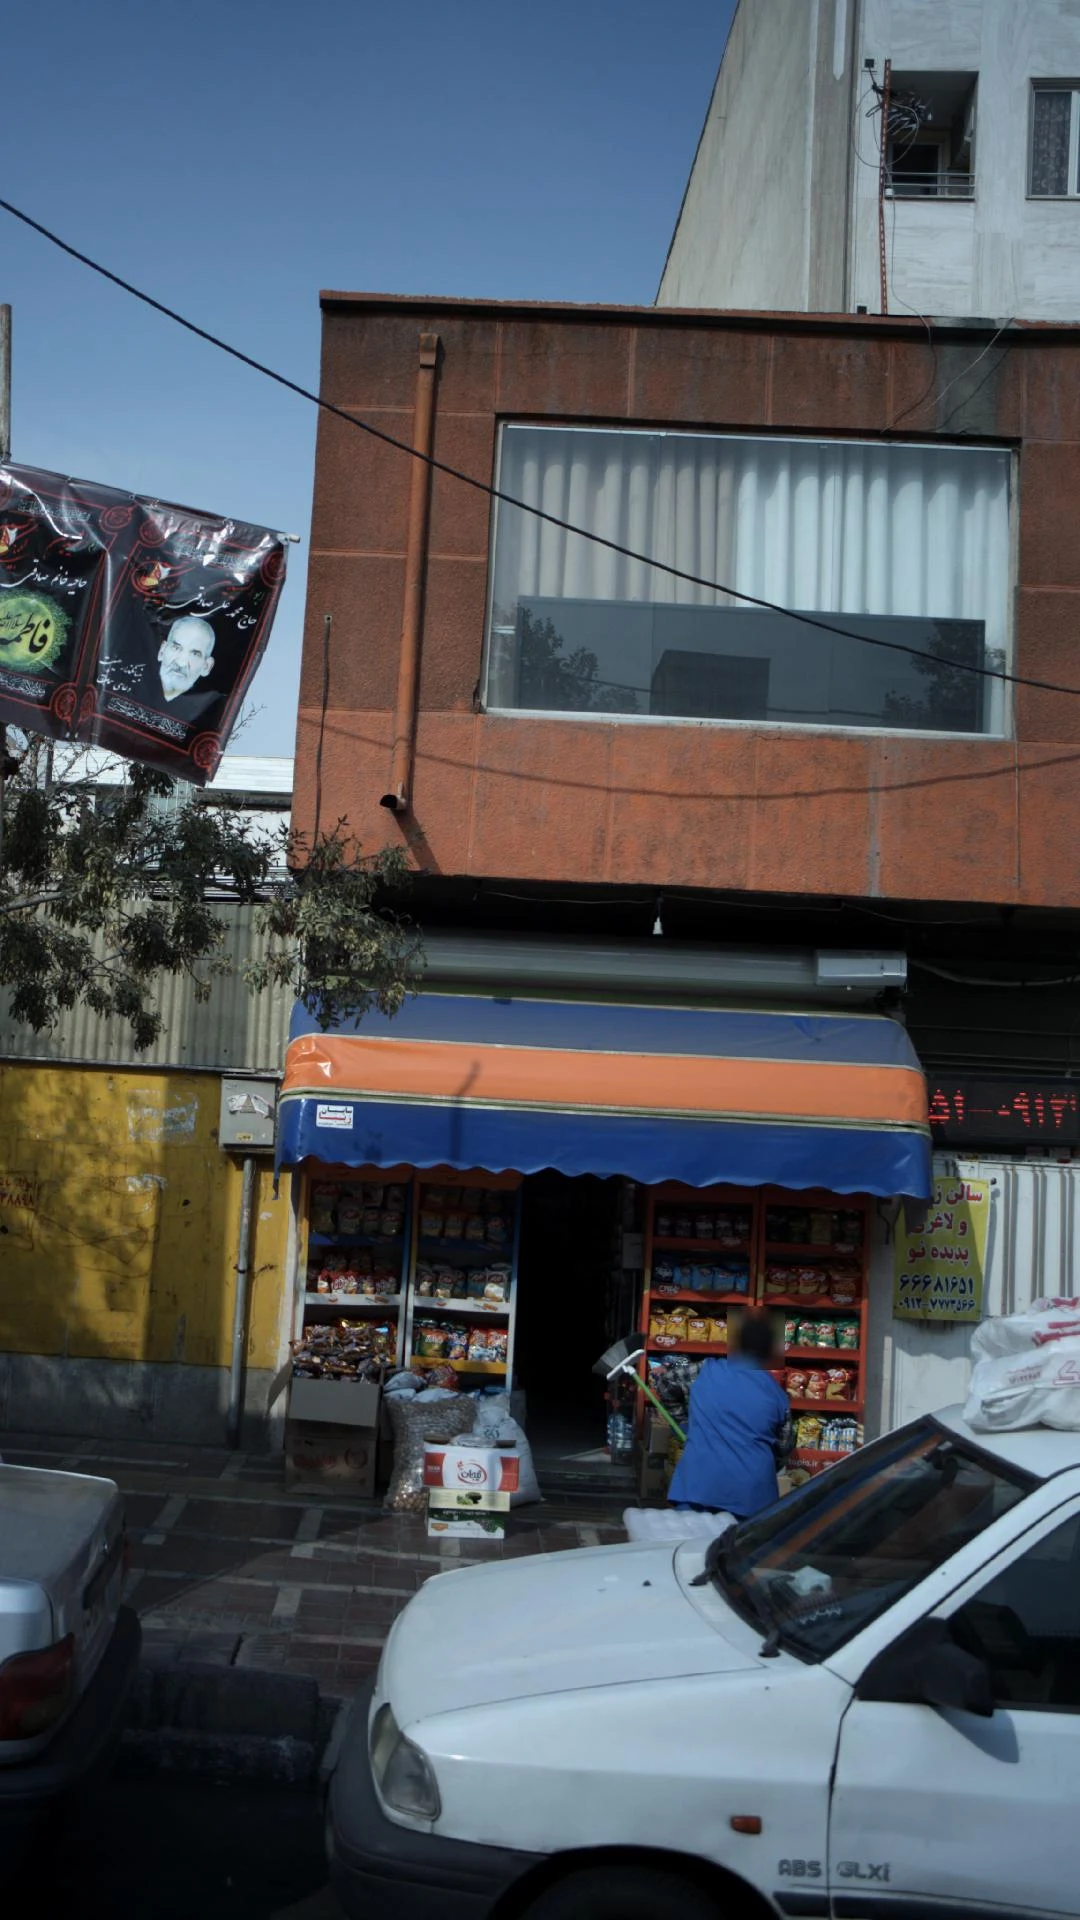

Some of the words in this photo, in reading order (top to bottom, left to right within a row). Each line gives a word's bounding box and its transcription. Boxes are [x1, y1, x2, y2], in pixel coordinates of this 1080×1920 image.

[51, 565, 68, 586] خانم
[189, 600, 230, 617] علی
[237, 614, 257, 630] حاج
[946, 1183, 983, 1206] سالن
[958, 1219, 967, 1236] و
[908, 1240, 926, 1264] نو
[931, 1246, 969, 1266] پدیده
[899, 1274, 974, 1295] ۶۶۶۸۱۶۵۱
[778, 1859, 822, 1878] ABS
